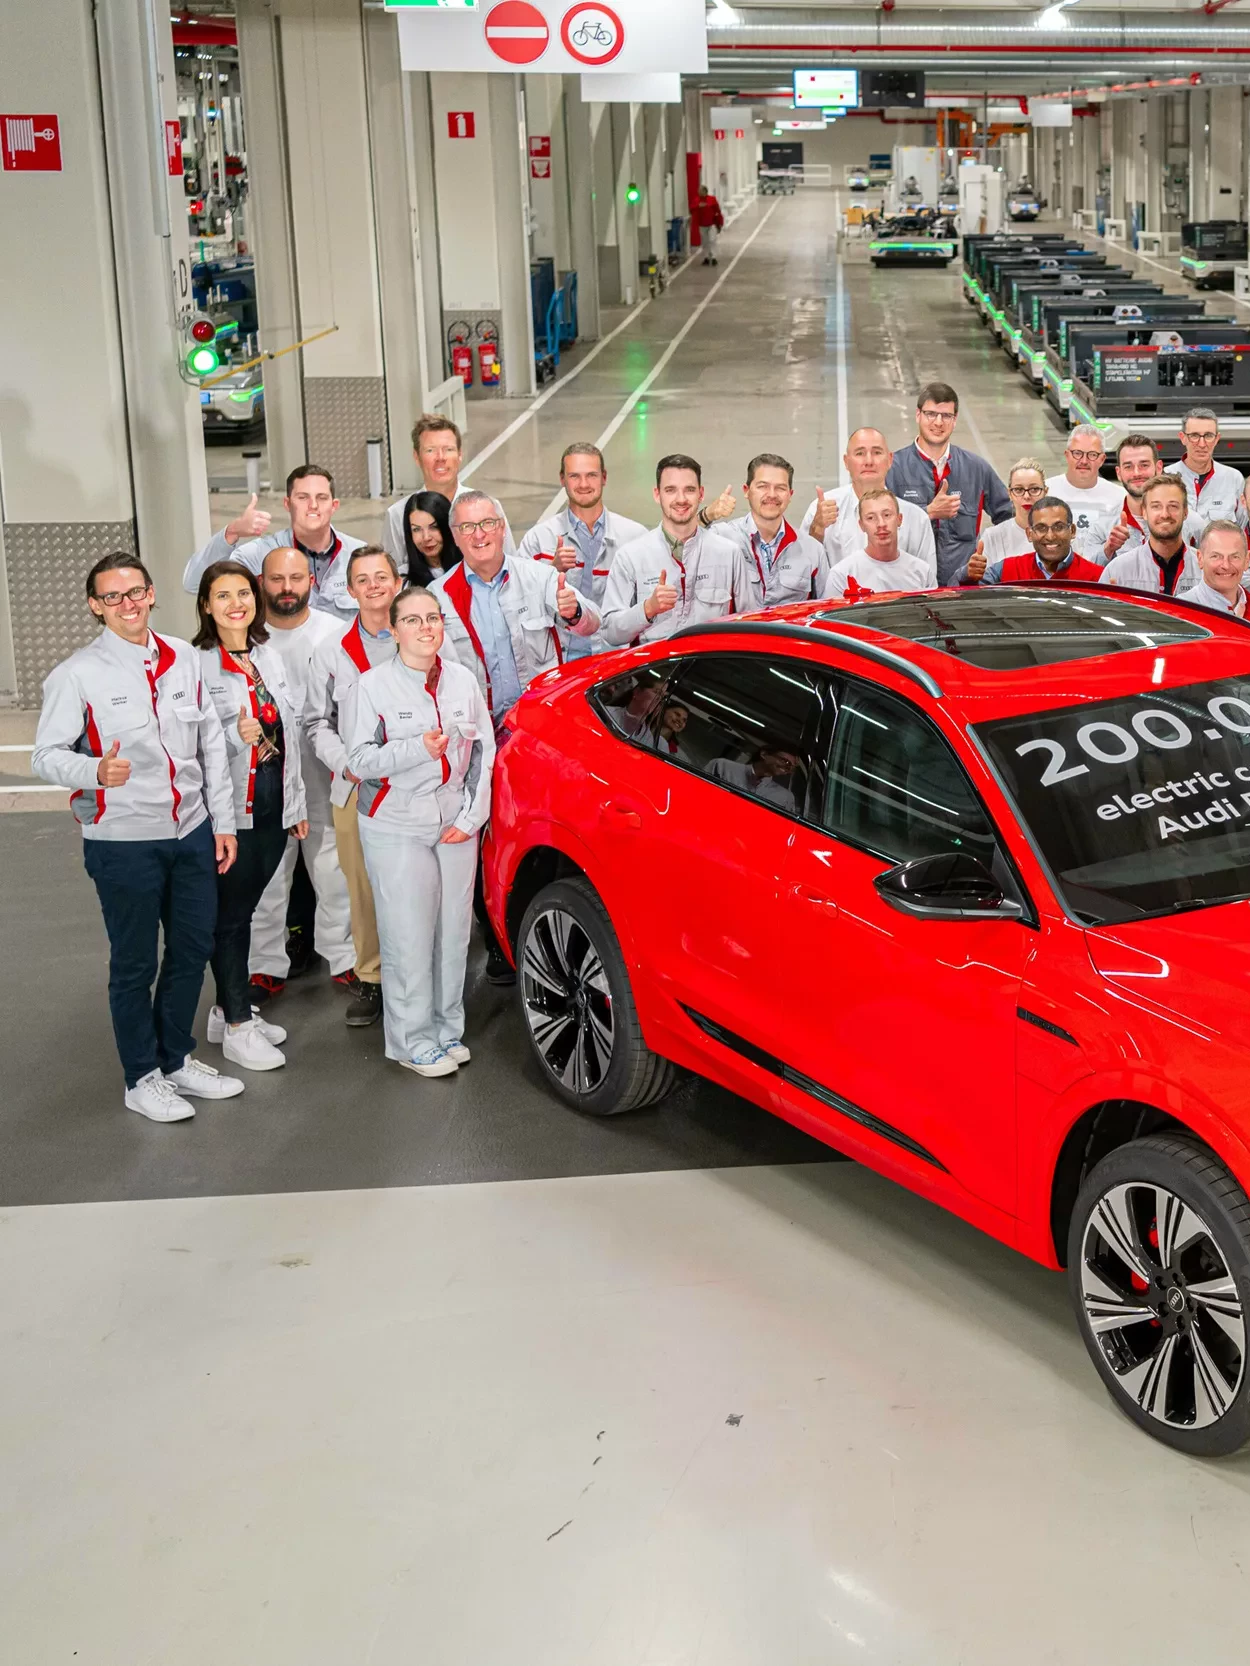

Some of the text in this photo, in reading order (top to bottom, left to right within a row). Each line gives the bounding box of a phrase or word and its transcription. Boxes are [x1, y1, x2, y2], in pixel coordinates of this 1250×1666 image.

[178, 258, 188, 298] D
[1076, 514, 1090, 529] &
[1096, 766, 1229, 821] electric
[1157, 798, 1242, 839] Audi
